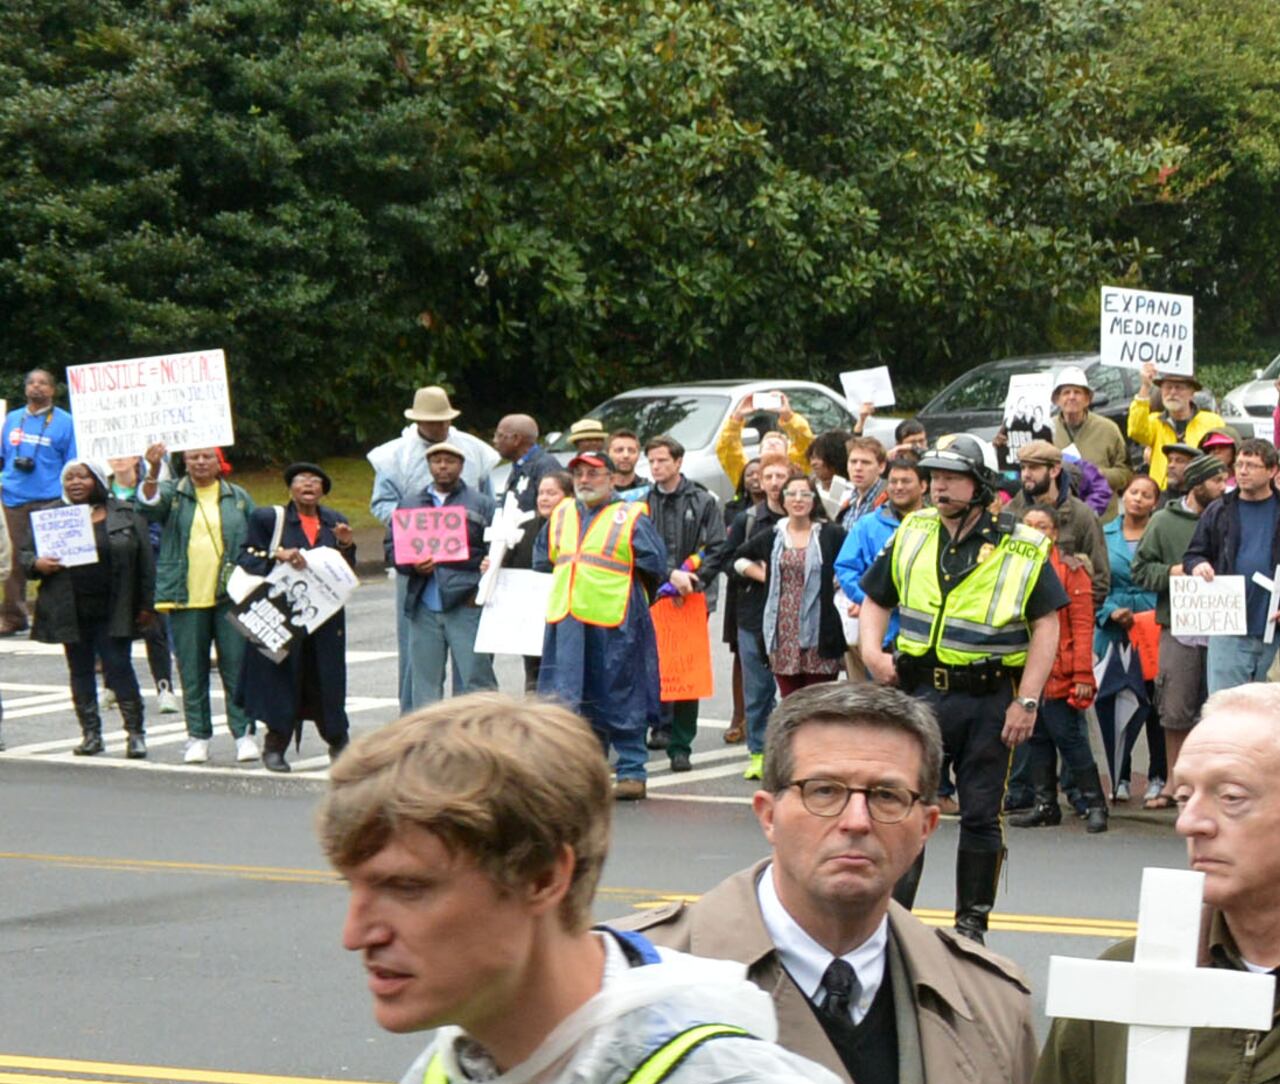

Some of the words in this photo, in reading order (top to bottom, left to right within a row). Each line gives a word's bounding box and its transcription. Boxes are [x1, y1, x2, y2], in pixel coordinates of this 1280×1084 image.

[1104, 293, 1182, 317] EXPAND
[1110, 316, 1188, 341] MEDICAID
[1120, 340, 1183, 367] NOW!
[69, 366, 87, 395] NO
[88, 360, 147, 393] JUSTICE
[159, 358, 178, 385] NO
[180, 352, 223, 383] PEACE
[162, 406, 195, 425] PEACE
[395, 512, 462, 531] VETO
[411, 537, 463, 555] 990
[1002, 538, 1041, 561] POLICE
[1173, 578, 1198, 593] NO
[249, 598, 287, 629] JOBS
[1172, 594, 1242, 611] COVERAGE
[238, 610, 284, 653] JUSTICE
[1198, 611, 1240, 632] DEAL
